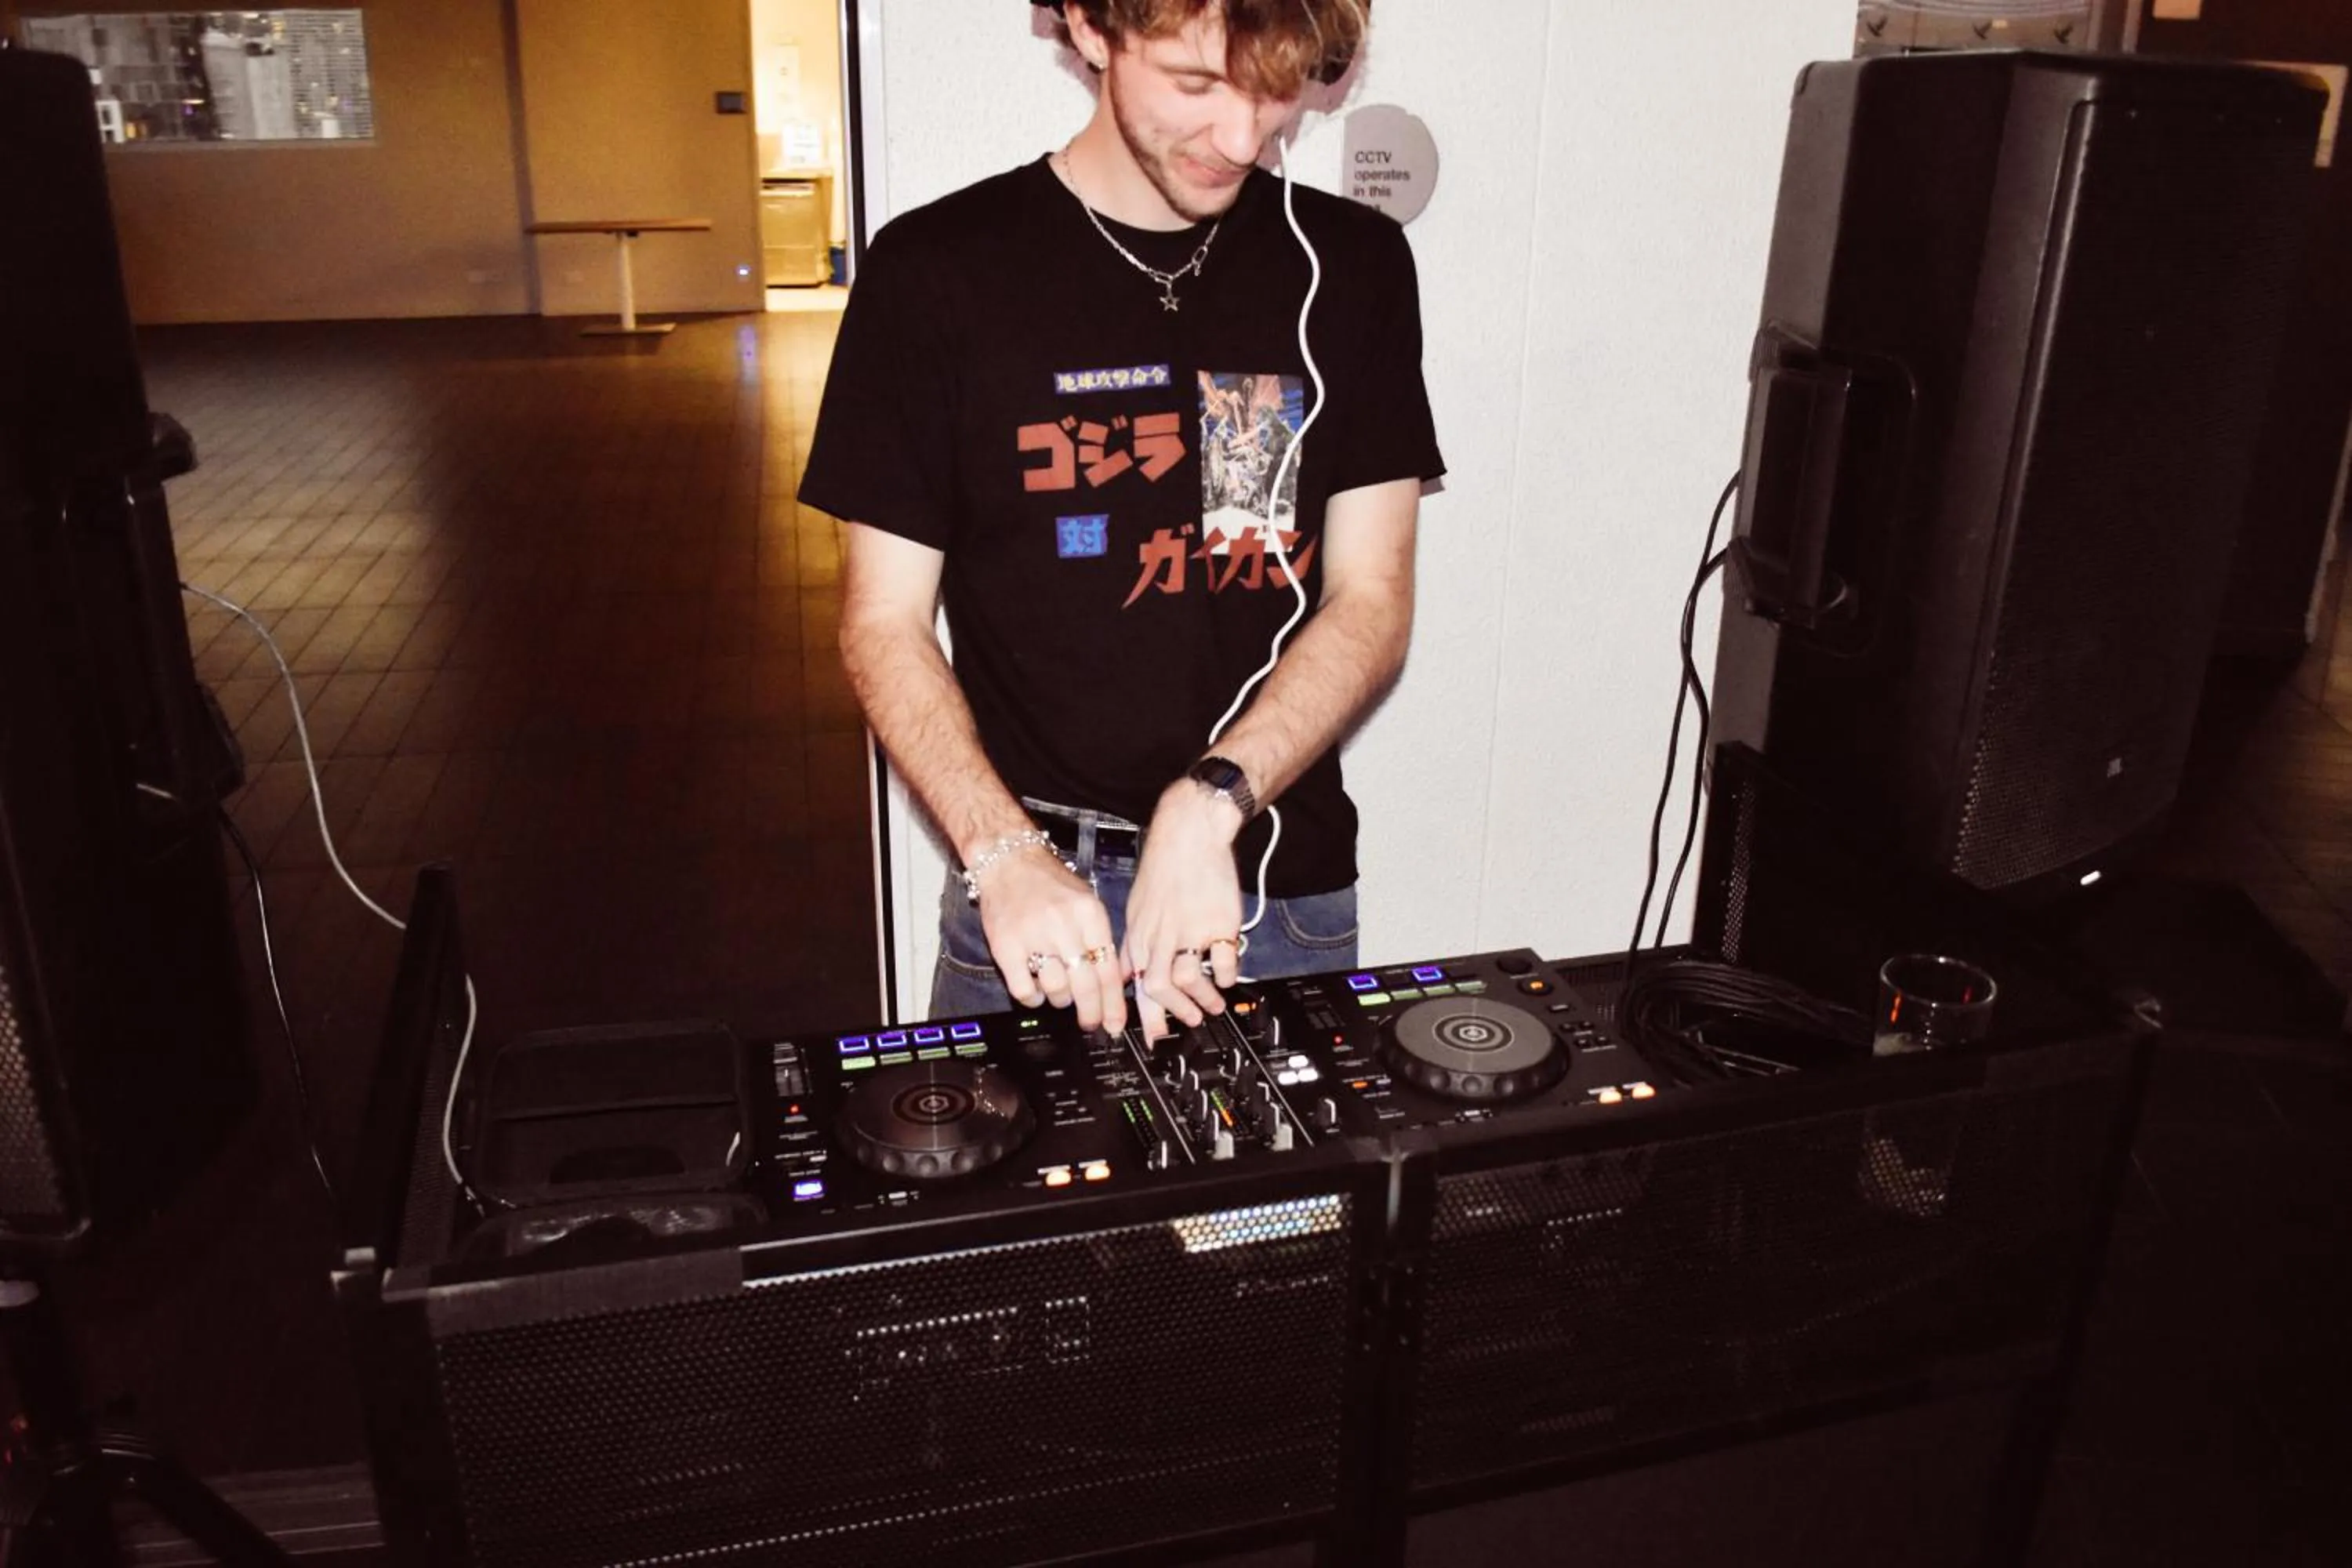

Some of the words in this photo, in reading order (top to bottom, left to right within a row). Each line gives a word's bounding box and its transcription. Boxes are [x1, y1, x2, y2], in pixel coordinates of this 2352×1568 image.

[1355, 151, 1392, 164] CCTV
[1354, 169, 1410, 183] operates
[1353, 184, 1365, 197] in
[1369, 185, 1392, 198] this
[1018, 412, 1187, 492] ゴジラ
